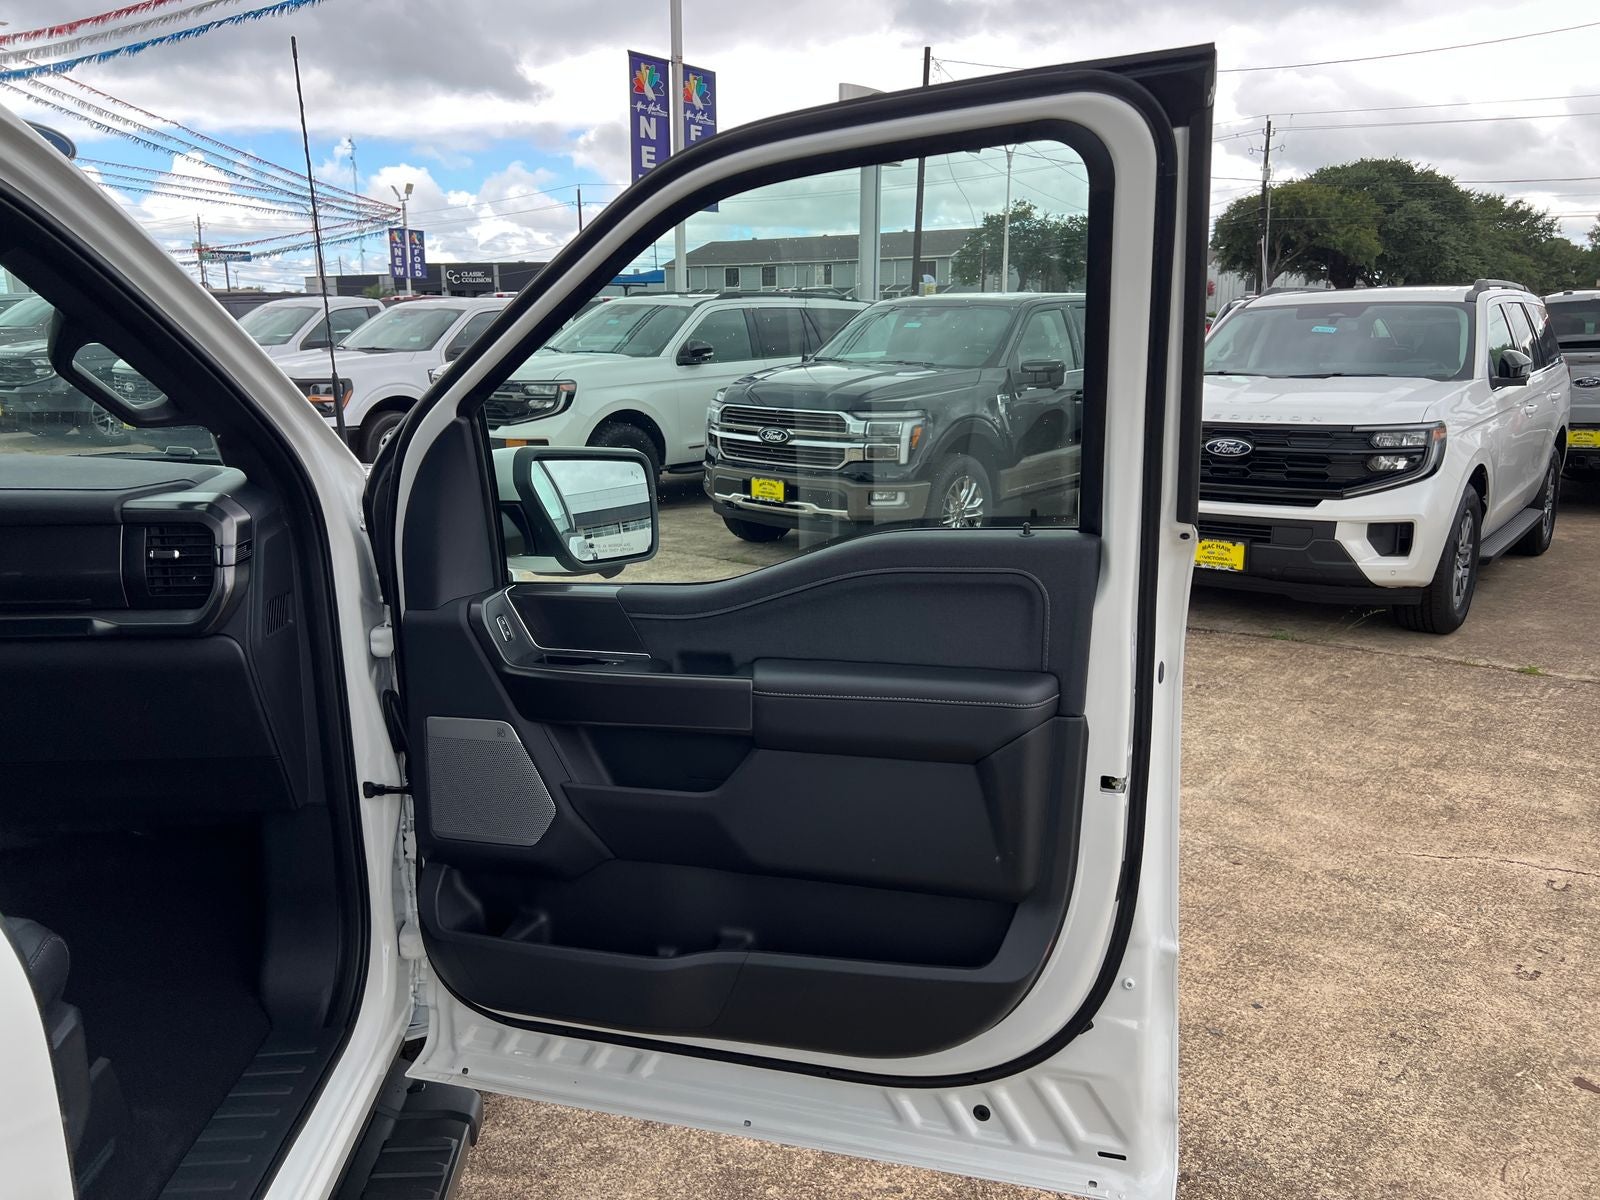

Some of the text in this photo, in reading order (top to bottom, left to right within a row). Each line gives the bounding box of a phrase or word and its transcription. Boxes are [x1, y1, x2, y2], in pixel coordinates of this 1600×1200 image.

[638, 115, 657, 179] NE
[394, 247, 404, 276] NEW
[414, 249, 422, 277] FORD
[1214, 440, 1243, 454] Ford
